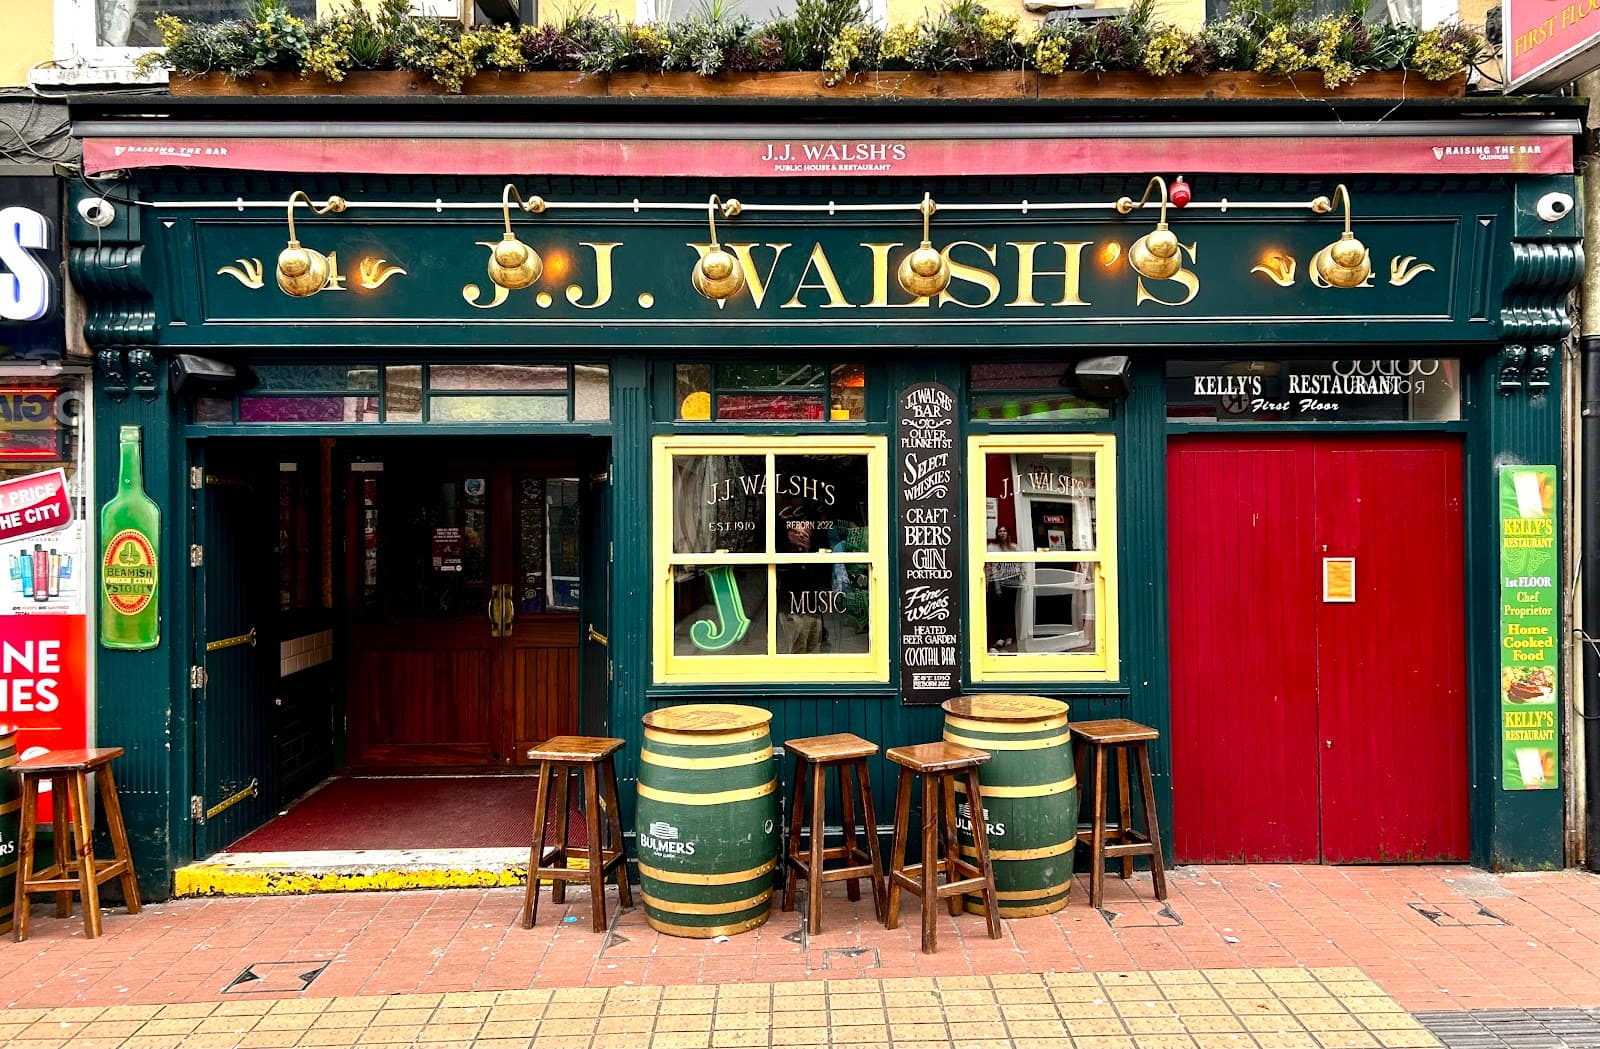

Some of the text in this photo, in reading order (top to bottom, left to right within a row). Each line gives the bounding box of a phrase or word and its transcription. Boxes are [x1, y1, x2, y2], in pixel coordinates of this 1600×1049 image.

[1514, 16, 1557, 57] FIRST
[205, 147, 228, 156] BAR
[762, 144, 906, 161] J.J. WALSH'S
[1445, 145, 1541, 155] RAISING THE BAR
[774, 164, 802, 172] PUBLIC
[804, 164, 830, 172] HOUSE
[1194, 376, 1262, 395] KELLY'S
[1288, 374, 1401, 395] RESTAURANT
[912, 404, 943, 418] BAR
[1251, 398, 1340, 412] First Floor
[909, 429, 947, 440] OLIVER
[901, 438, 941, 449] PLUNKETT
[904, 452, 949, 485] SELECT
[707, 478, 735, 505] J.J.
[904, 470, 951, 502] WHISKIES
[1000, 472, 1085, 501] J.J. WALSH'S
[8, 482, 57, 507] PRICE
[24, 502, 61, 524] CITY
[906, 508, 949, 524] CRAFT
[734, 520, 756, 531] 1910
[786, 520, 815, 530] REBORN
[817, 520, 834, 530] 2022
[1503, 519, 1553, 535] KELLY'S
[904, 525, 952, 546] BEERS
[1503, 538, 1553, 548] RESTAURANT
[912, 548, 947, 570] GIN
[107, 567, 152, 578] BEAMISH
[906, 569, 953, 580] PORTFOLIO
[112, 584, 145, 594] STOUT
[1518, 576, 1552, 588] FLOOR
[789, 590, 848, 615] MUSIC
[1516, 591, 1540, 603] Chef
[690, 565, 751, 651] J
[1504, 604, 1553, 619] Proprietor
[914, 625, 947, 635] HEATED
[1508, 624, 1549, 635] Home
[903, 634, 957, 645] BEER GARDEN
[1504, 637, 1553, 649] Cooked
[905, 646, 957, 667] COCKTAIL BAR
[1512, 649, 1545, 662] Food
[1505, 711, 1553, 728] KELLY'S
[1505, 730, 1553, 741] RESTAURANT
[640, 833, 695, 855] BULMERS
